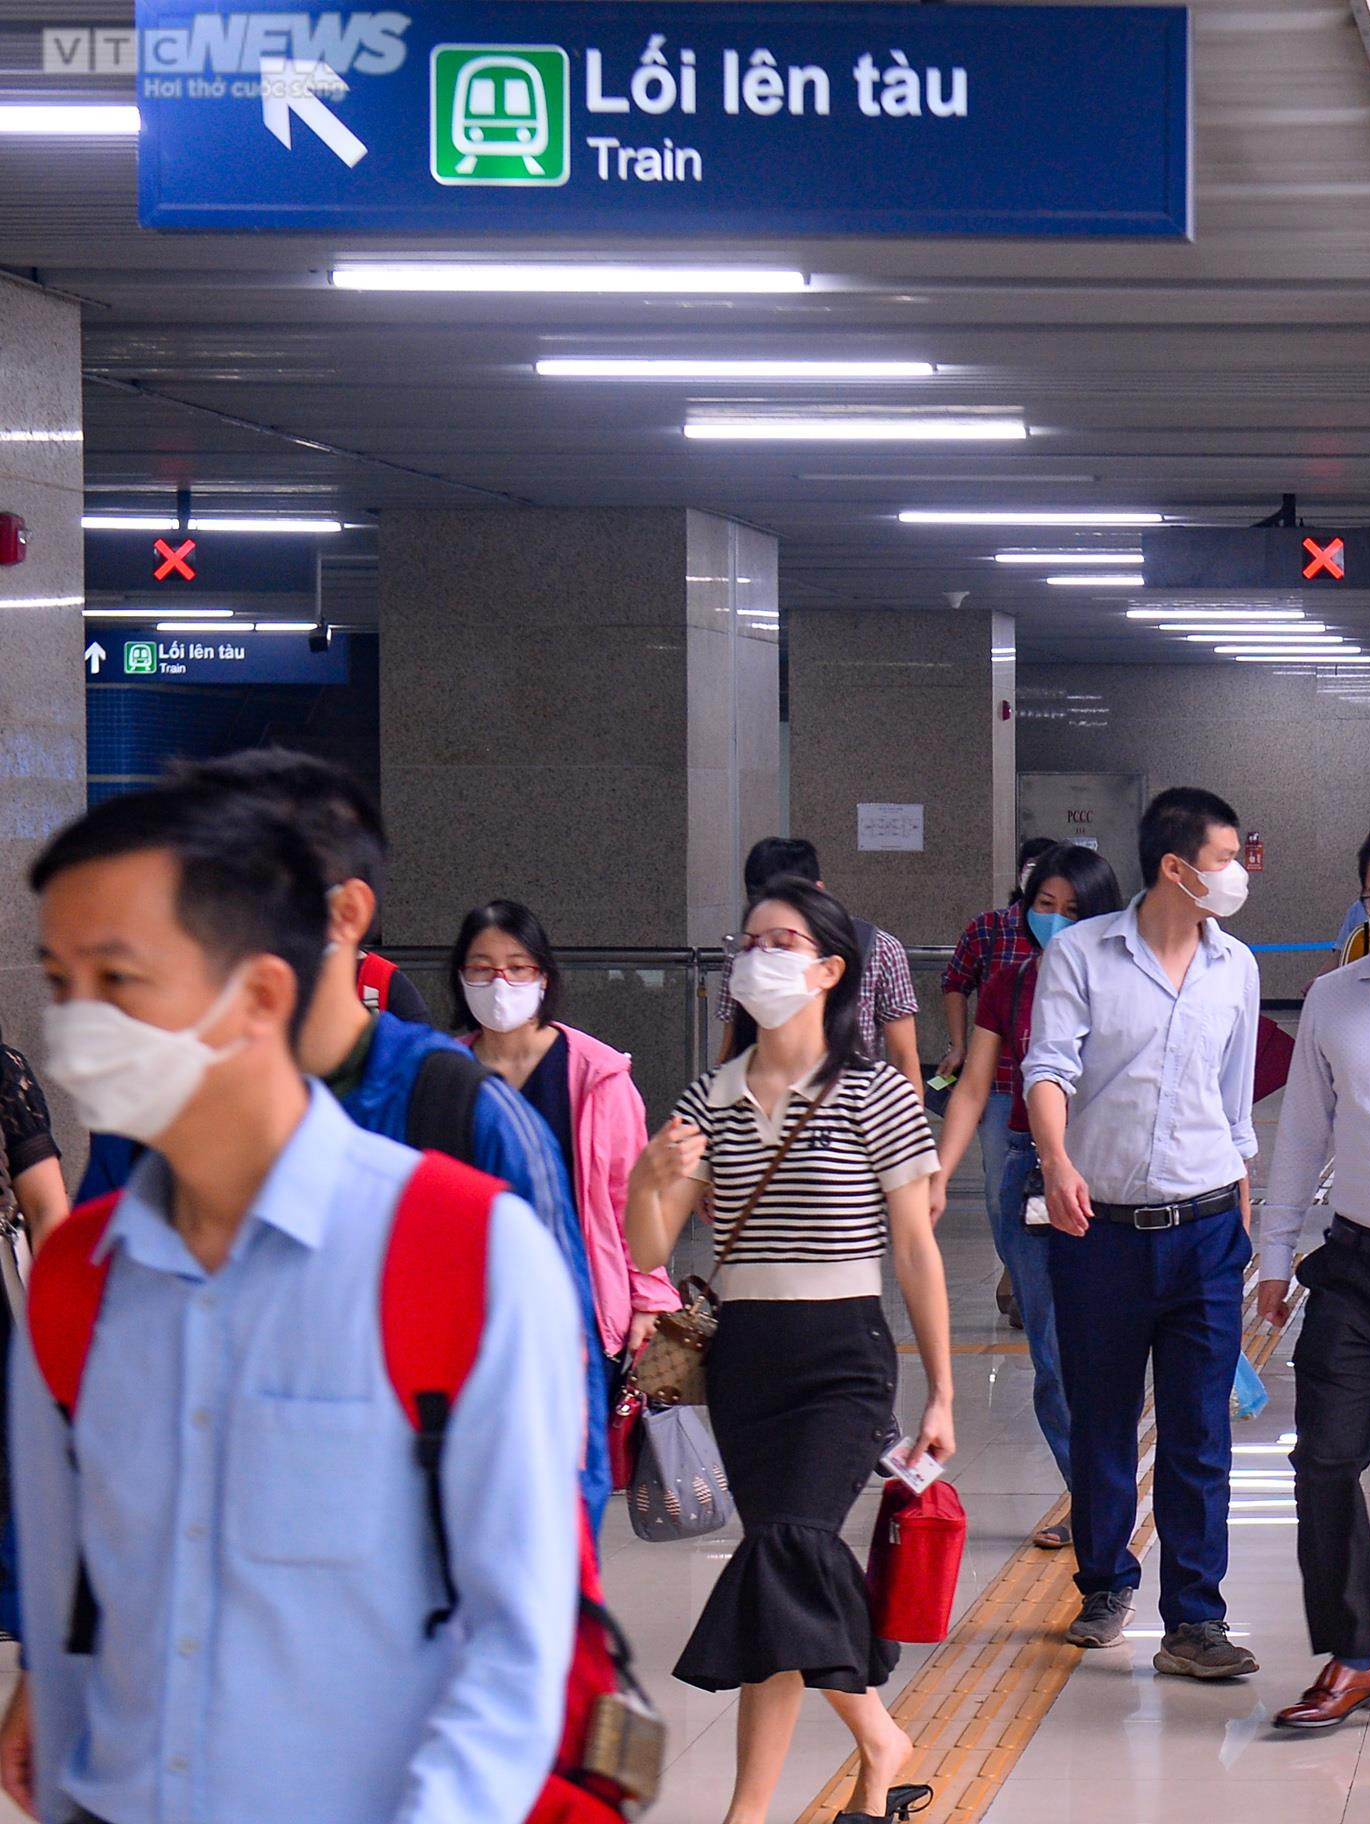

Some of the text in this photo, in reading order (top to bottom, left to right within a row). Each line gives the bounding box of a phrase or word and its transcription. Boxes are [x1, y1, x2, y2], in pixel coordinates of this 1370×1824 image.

[586, 34, 968, 117] Lối lên tàu
[586, 136, 703, 183] Train
[158, 640, 245, 660] Lối lên tàu
[159, 662, 187, 674] Train
[1067, 809, 1094, 824] PCCC
